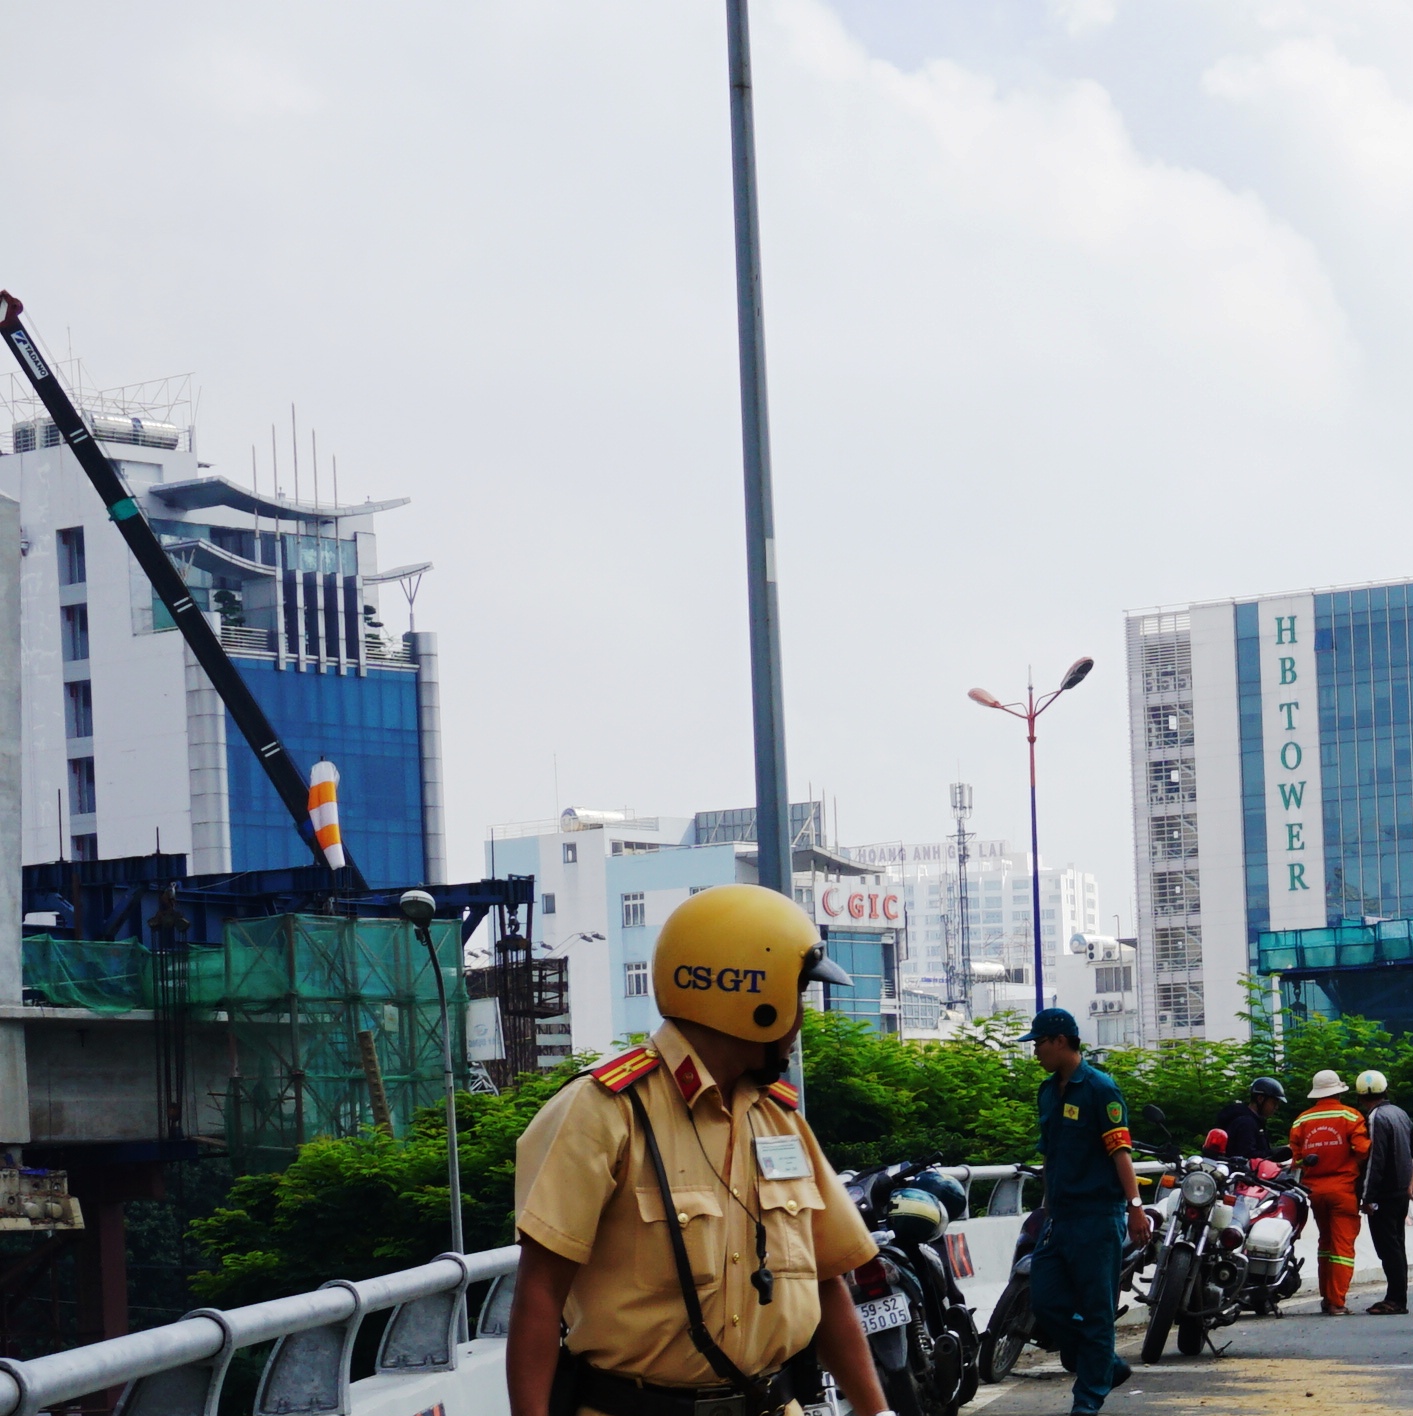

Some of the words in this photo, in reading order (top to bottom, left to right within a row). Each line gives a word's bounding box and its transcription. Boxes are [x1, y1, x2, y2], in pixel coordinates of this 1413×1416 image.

[25, 345, 47, 377] TADANO
[1275, 615, 1298, 685] HB
[1277, 701, 1311, 892] TOWER
[913, 846, 940, 861] ANH
[847, 892, 899, 920] GIC
[674, 964, 766, 993] CSGT
[860, 1297, 900, 1319] 59-S2
